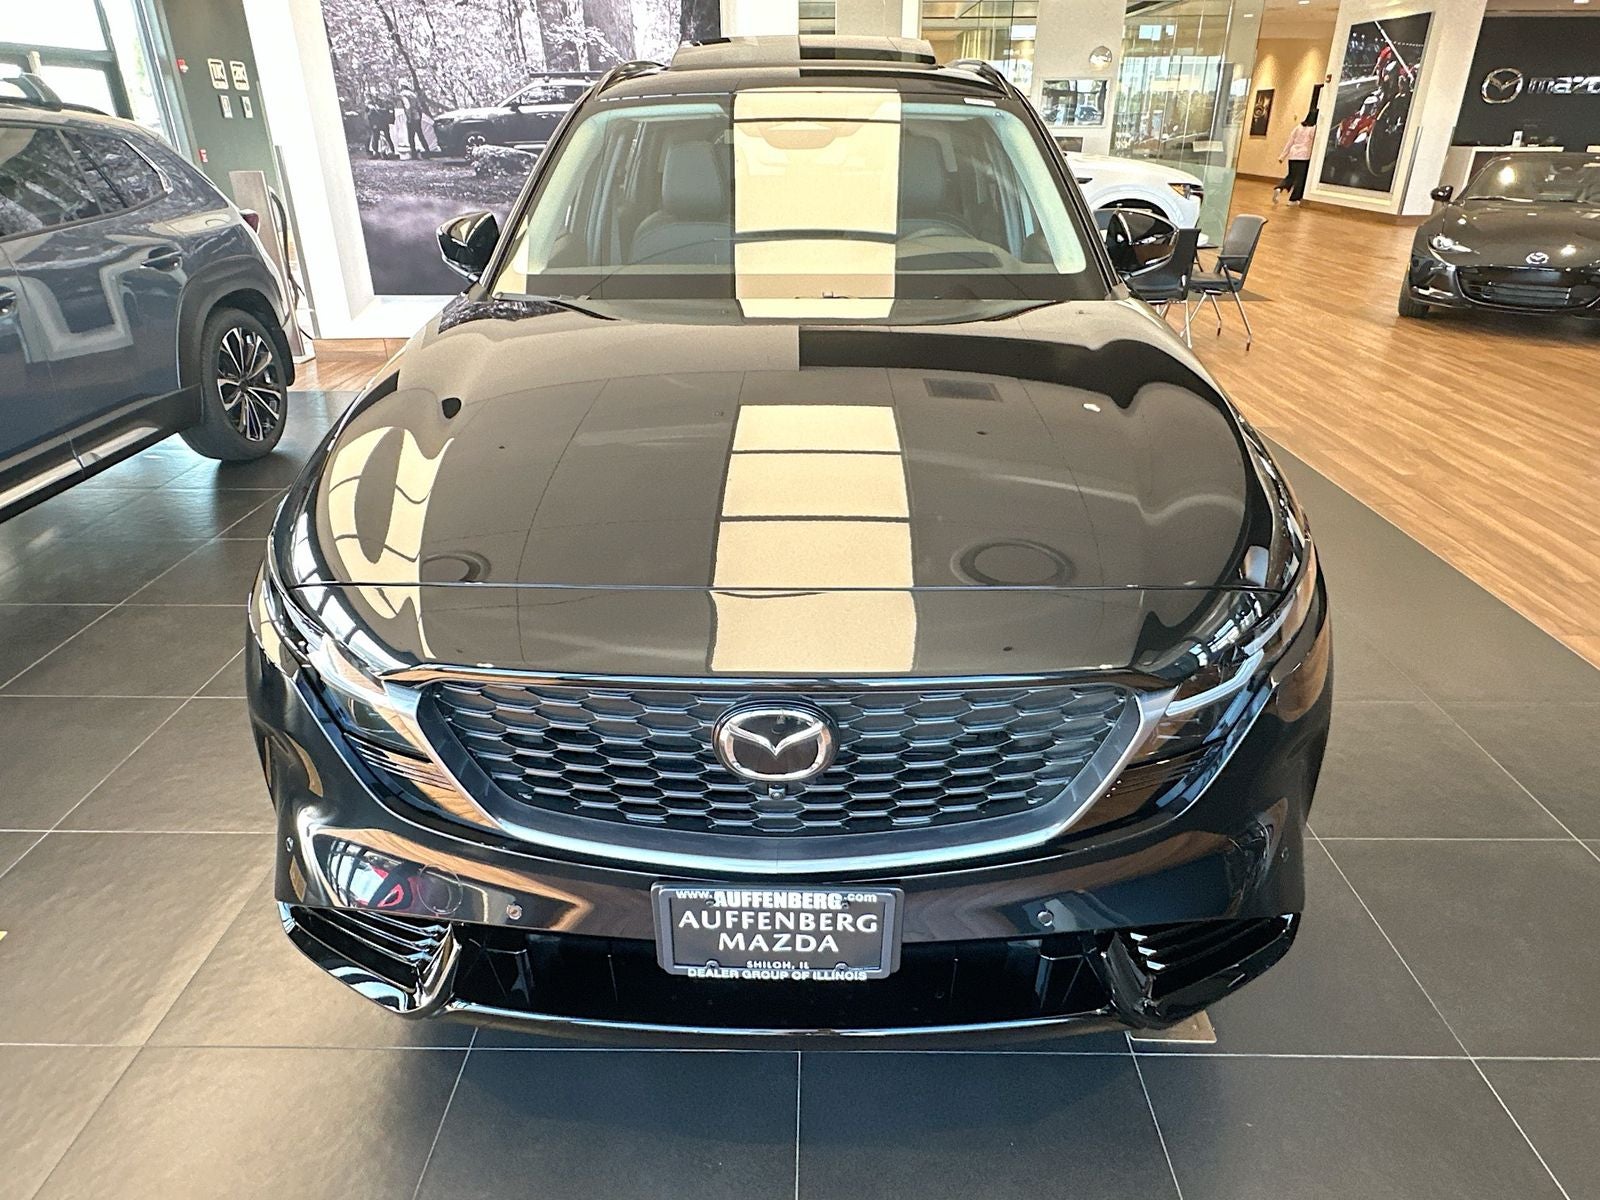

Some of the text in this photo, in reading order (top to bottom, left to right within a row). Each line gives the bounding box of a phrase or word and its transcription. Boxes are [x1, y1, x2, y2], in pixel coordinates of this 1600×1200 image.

[678, 910, 878, 933] AUFFENBERG
[718, 932, 839, 952] MAZDA
[746, 960, 810, 970] SHILOH, IL
[687, 967, 868, 981] DEALER GROUP OF ILLINOIS
